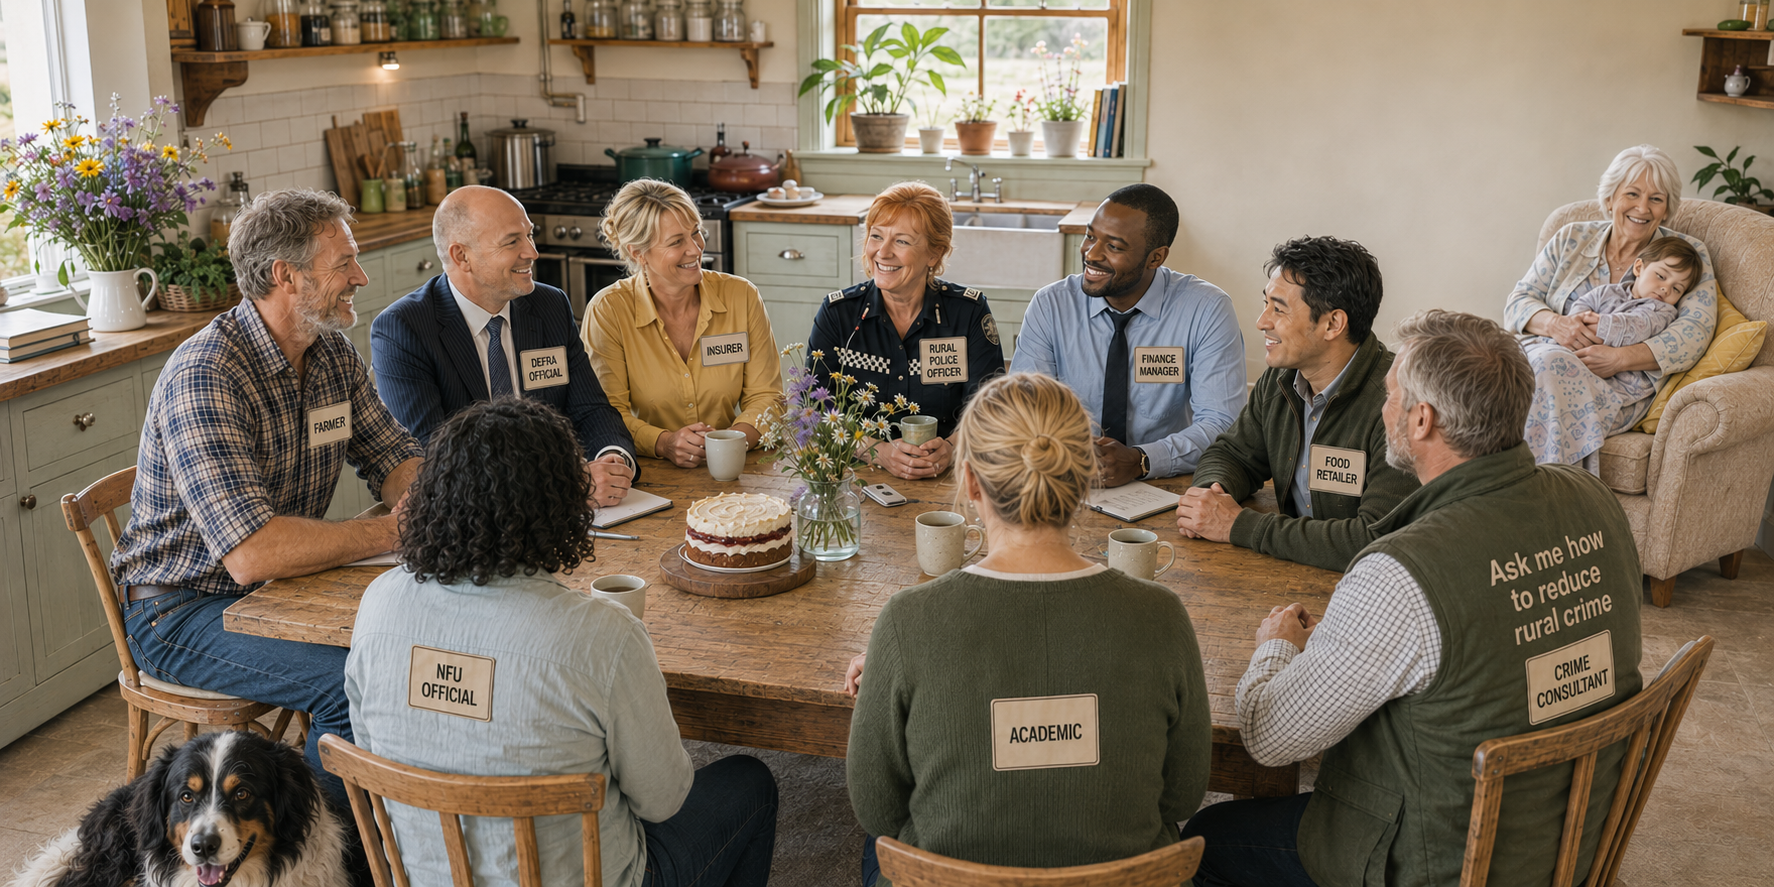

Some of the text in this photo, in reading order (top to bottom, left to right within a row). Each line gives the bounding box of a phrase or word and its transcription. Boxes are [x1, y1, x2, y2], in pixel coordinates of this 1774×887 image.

[707, 343, 743, 356] INSURER
[929, 343, 957, 354] RURAL
[531, 356, 557, 368] DEFRA
[929, 355, 958, 366] POLICE
[1141, 354, 1176, 364] FINANCE
[528, 368, 563, 381] OFFICIAL
[927, 367, 962, 378] OFFICER
[1139, 366, 1180, 377] MANAGER
[314, 416, 346, 434] FARMER
[1325, 456, 1351, 469] FOOD
[1317, 469, 1358, 485] RETAILER
[1489, 530, 1605, 587] Ask me how
[1510, 564, 1601, 612] to reduce
[1514, 593, 1613, 645] rural crime
[436, 663, 462, 682] NFU
[1554, 654, 1591, 681] CRIME
[421, 681, 477, 706] OFFICIAL
[1536, 668, 1609, 709] CONSULTANT
[1010, 723, 1082, 744] ACADEMIC
